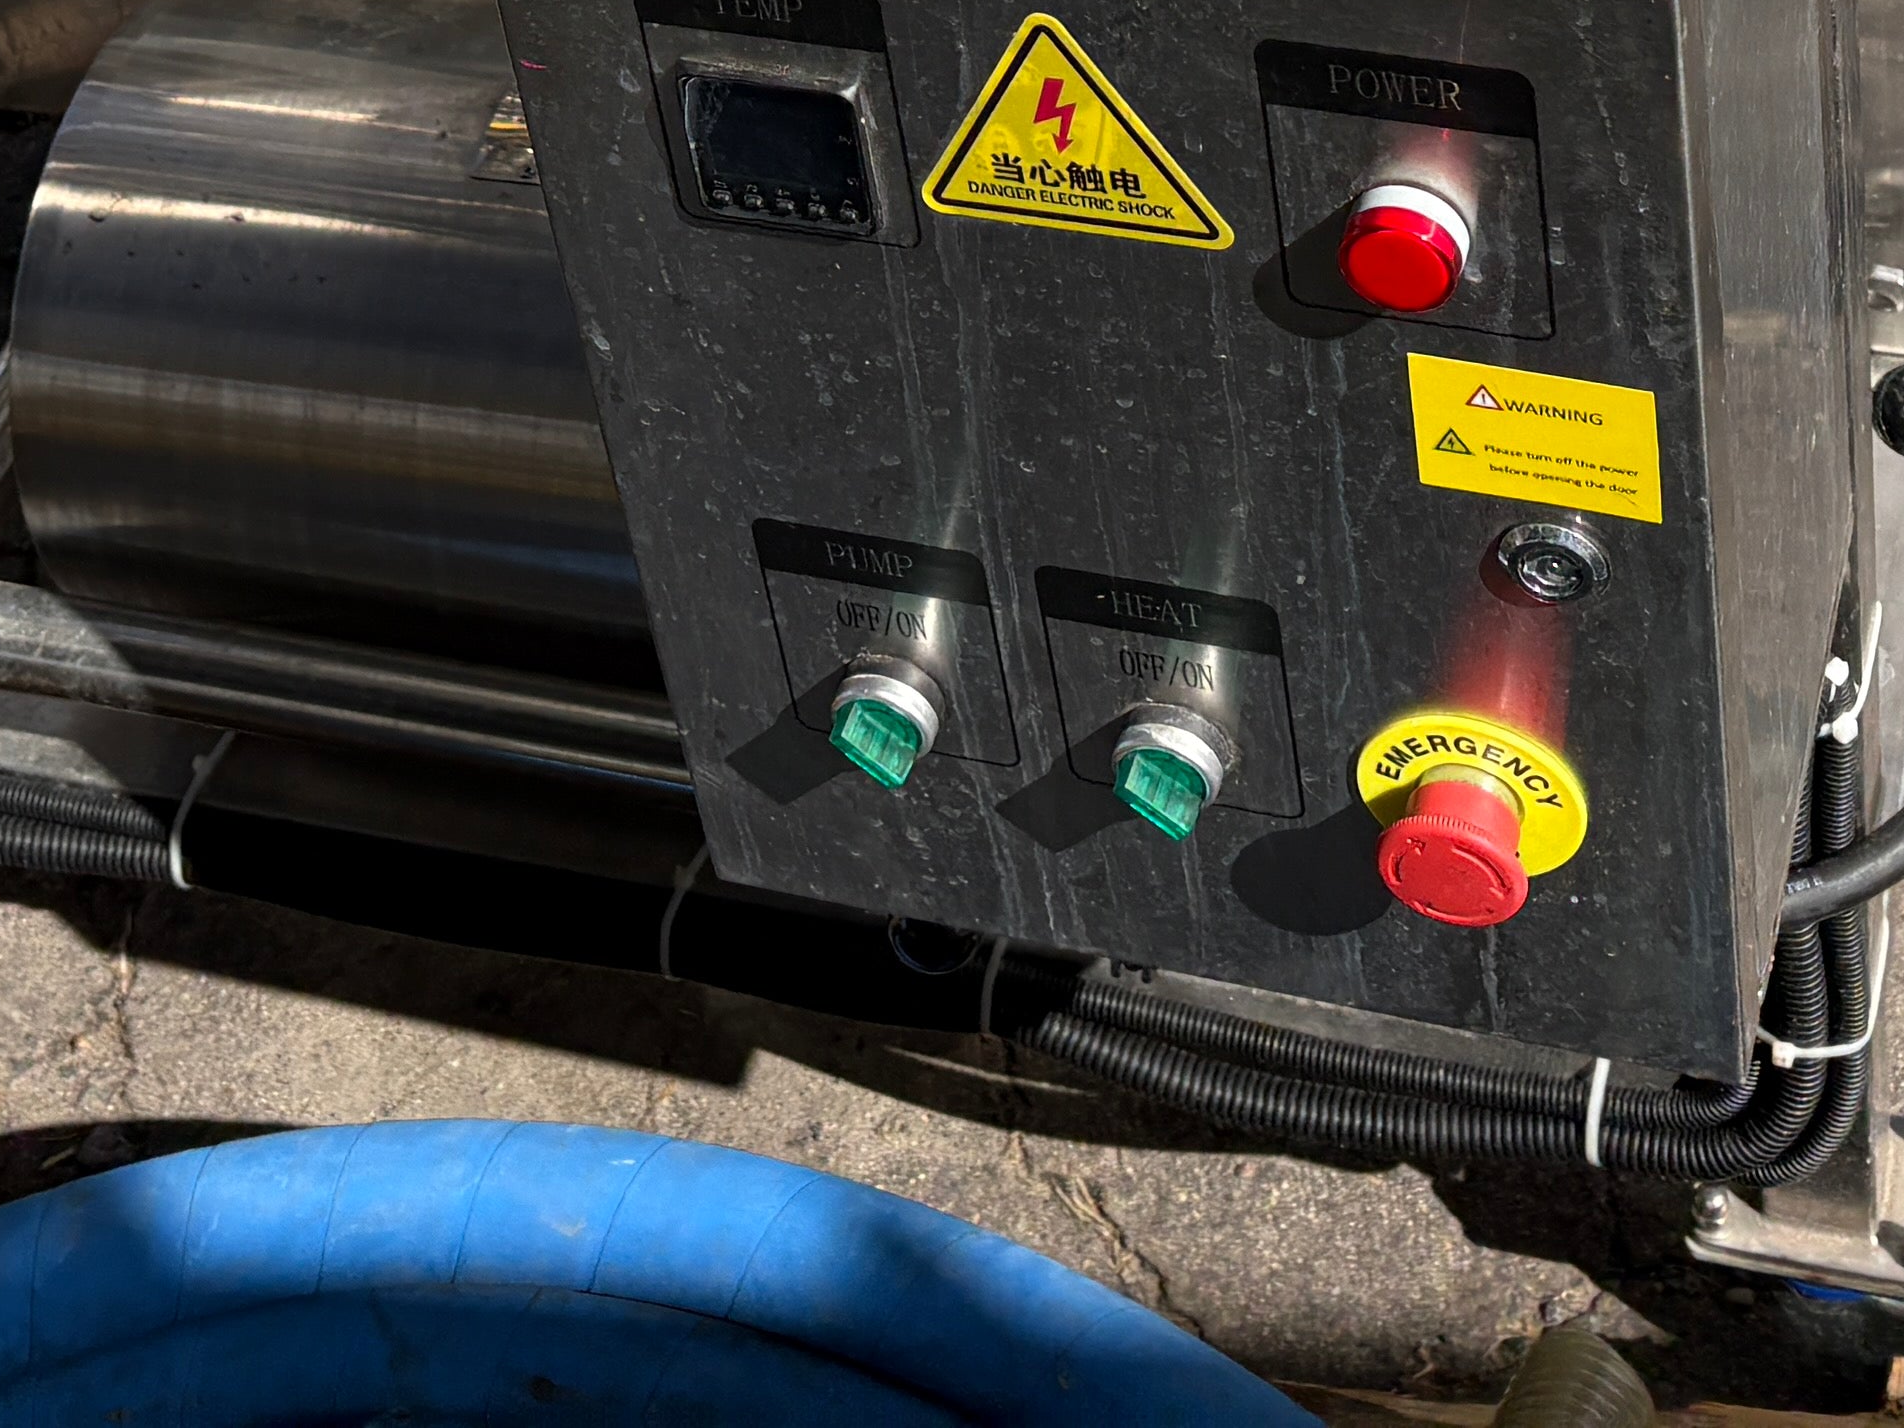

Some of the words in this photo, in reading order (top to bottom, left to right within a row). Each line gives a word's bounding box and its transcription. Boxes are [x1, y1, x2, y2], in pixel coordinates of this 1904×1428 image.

[1327, 63, 1462, 111] POWER
[990, 151, 1146, 199] 当心触电
[967, 180, 1037, 203] DANGER
[1039, 189, 1114, 212] ELECTRIC
[1117, 199, 1176, 220] SHOCK
[1503, 398, 1603, 426] WARNING
[1484, 444, 1522, 458] Please
[1526, 451, 1553, 462] turn
[1555, 456, 1573, 465] off
[1575, 460, 1596, 470] the
[1599, 465, 1639, 478] power
[1489, 463, 1529, 476] before
[1532, 472, 1582, 488] opening
[1585, 480, 1605, 489] the
[1608, 484, 1639, 495] door
[824, 541, 913, 578] PUMP
[836, 599, 927, 640] OFF/ON
[1111, 590, 1203, 628] HEAT
[1119, 648, 1215, 691] OFF/ON
[1376, 734, 1564, 809] EMERGENCY
